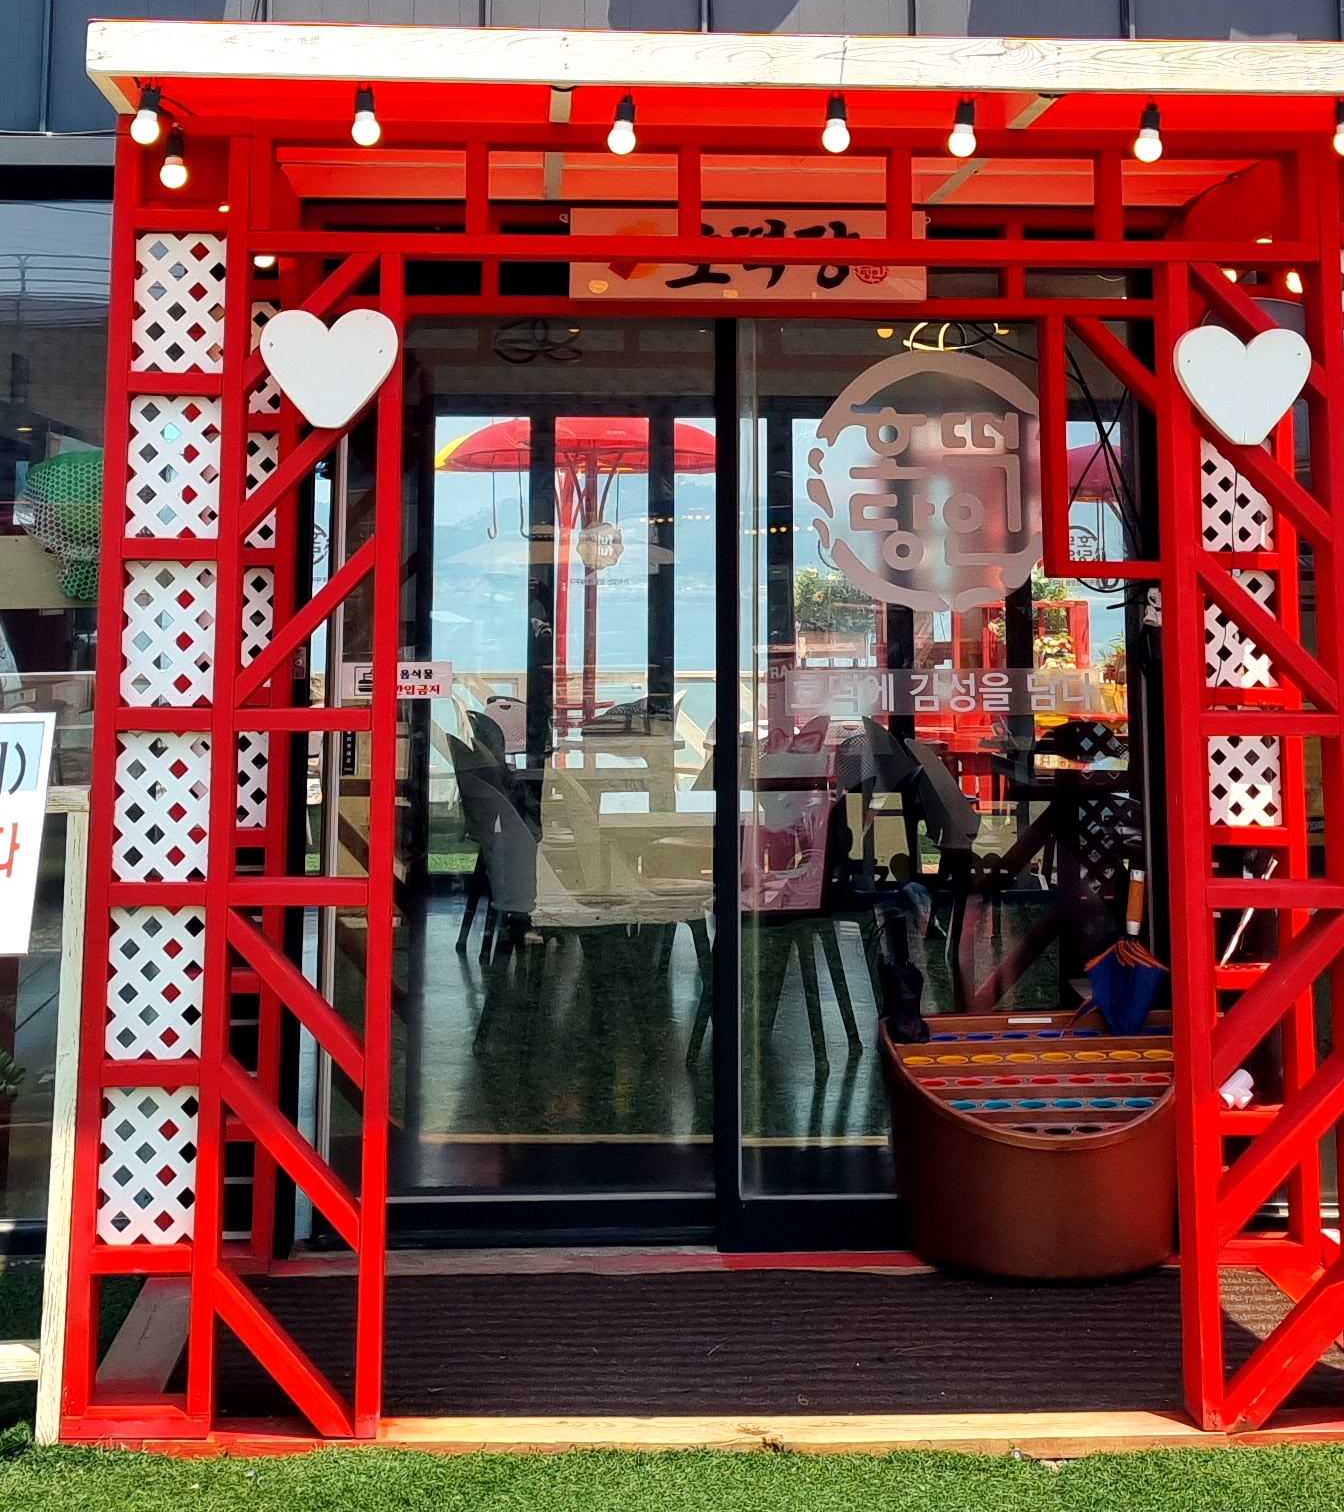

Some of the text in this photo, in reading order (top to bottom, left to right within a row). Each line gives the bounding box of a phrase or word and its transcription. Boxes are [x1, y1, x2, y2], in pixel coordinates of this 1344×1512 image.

[400, 669, 434, 679] 음식물
[909, 672, 1013, 712] 감성을
[1026, 672, 1096, 712] 담다
